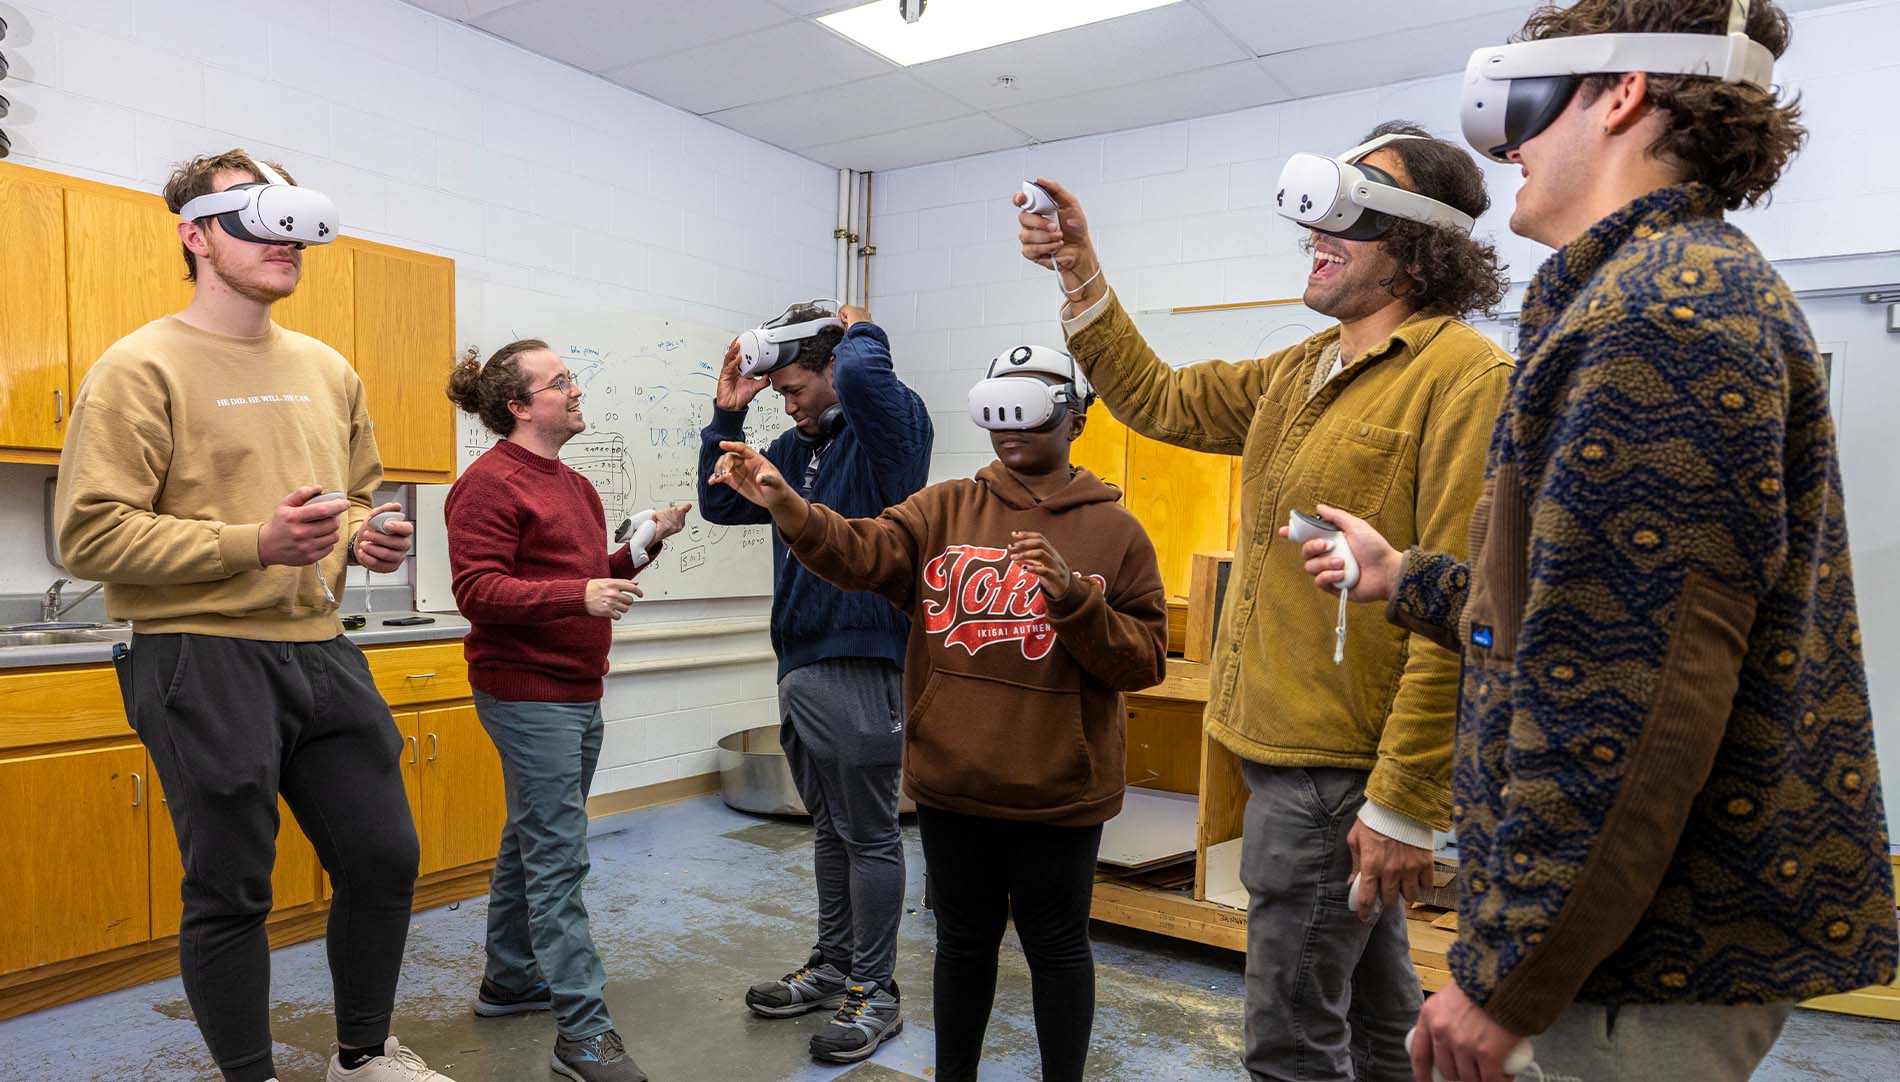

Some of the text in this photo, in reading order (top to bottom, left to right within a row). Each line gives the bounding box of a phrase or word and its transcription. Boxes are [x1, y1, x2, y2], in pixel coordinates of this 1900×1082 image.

[216, 399, 230, 407] HE
[248, 396, 260, 404] HE
[922, 544, 1107, 660] Tok
[976, 623, 1051, 638] IKIGAI AUTHEN
